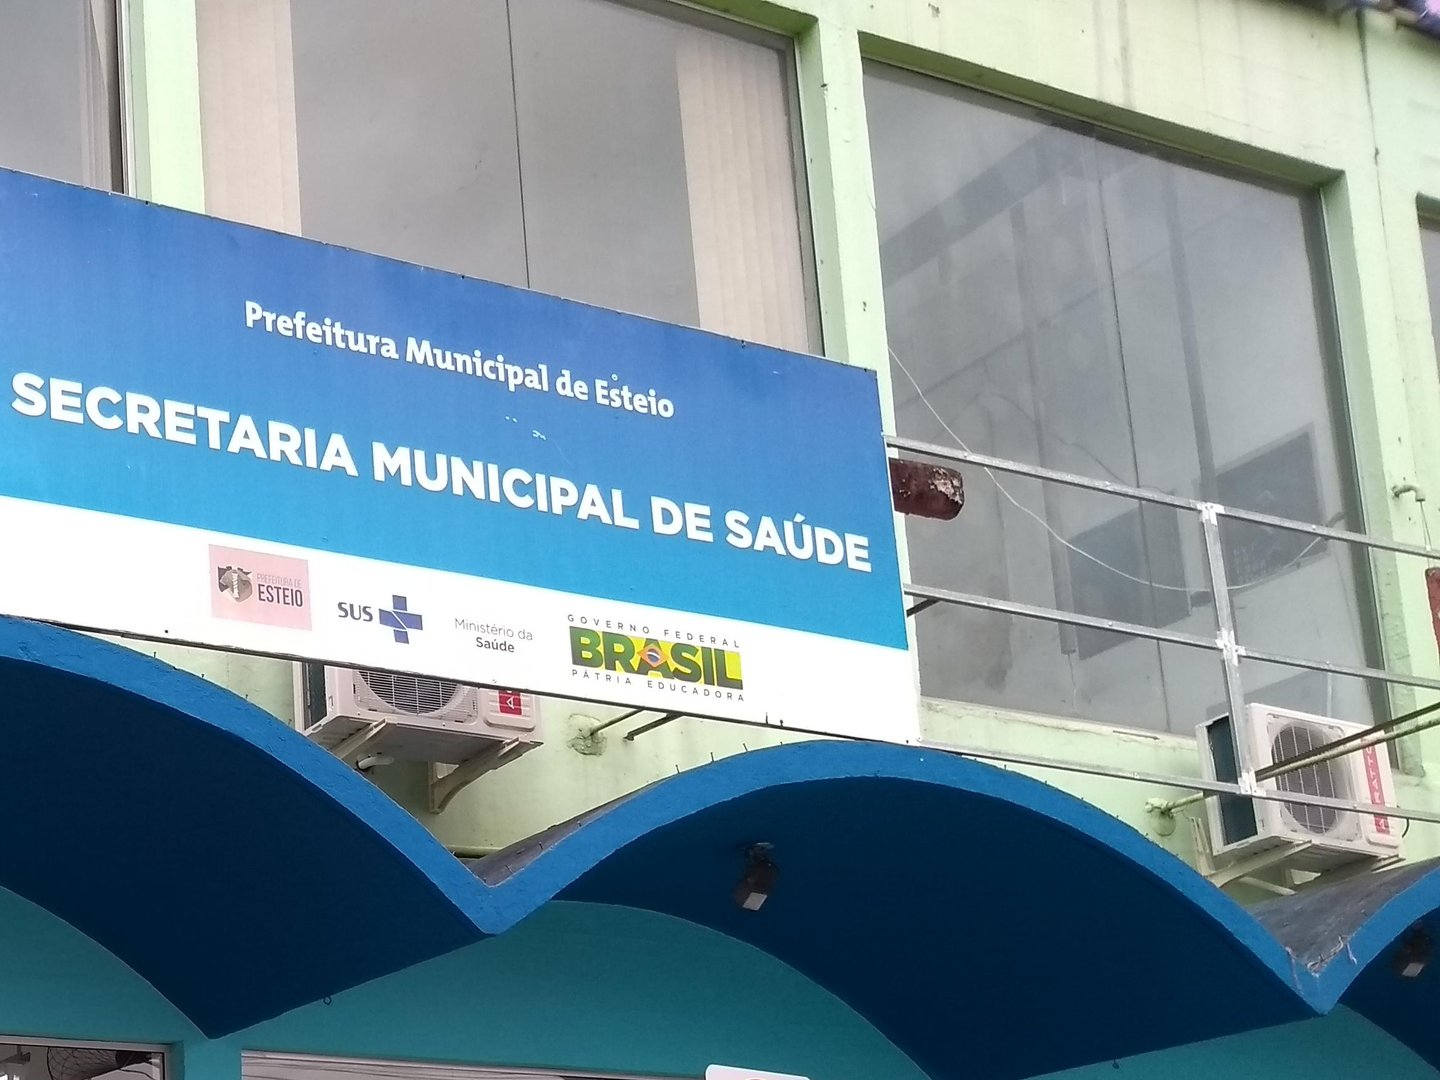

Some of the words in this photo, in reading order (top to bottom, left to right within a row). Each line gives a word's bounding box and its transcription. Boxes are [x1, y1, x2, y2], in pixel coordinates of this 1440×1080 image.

[245, 300, 399, 360] Prefeitura
[405, 336, 549, 392] Municipal
[556, 370, 588, 401] de
[594, 378, 675, 419] Esteio
[10, 371, 359, 477] SECRETARIA
[371, 441, 640, 530] MUNICIPAL
[651, 495, 714, 543] DE
[724, 512, 872, 573] SAÚDE
[256, 573, 293, 587] PREFEITURA
[294, 578, 302, 589] DE
[258, 583, 303, 607] ESTEIO
[337, 601, 373, 622] SUS
[454, 617, 514, 639] Ministério
[517, 628, 533, 641] da
[567, 614, 650, 634] GOVERNO
[664, 629, 740, 648] FEDERAL
[475, 636, 515, 653] Saúde
[569, 625, 743, 690] BRASIL
[572, 668, 631, 685] PÁTRIA
[647, 680, 744, 701] EDUCADORA
